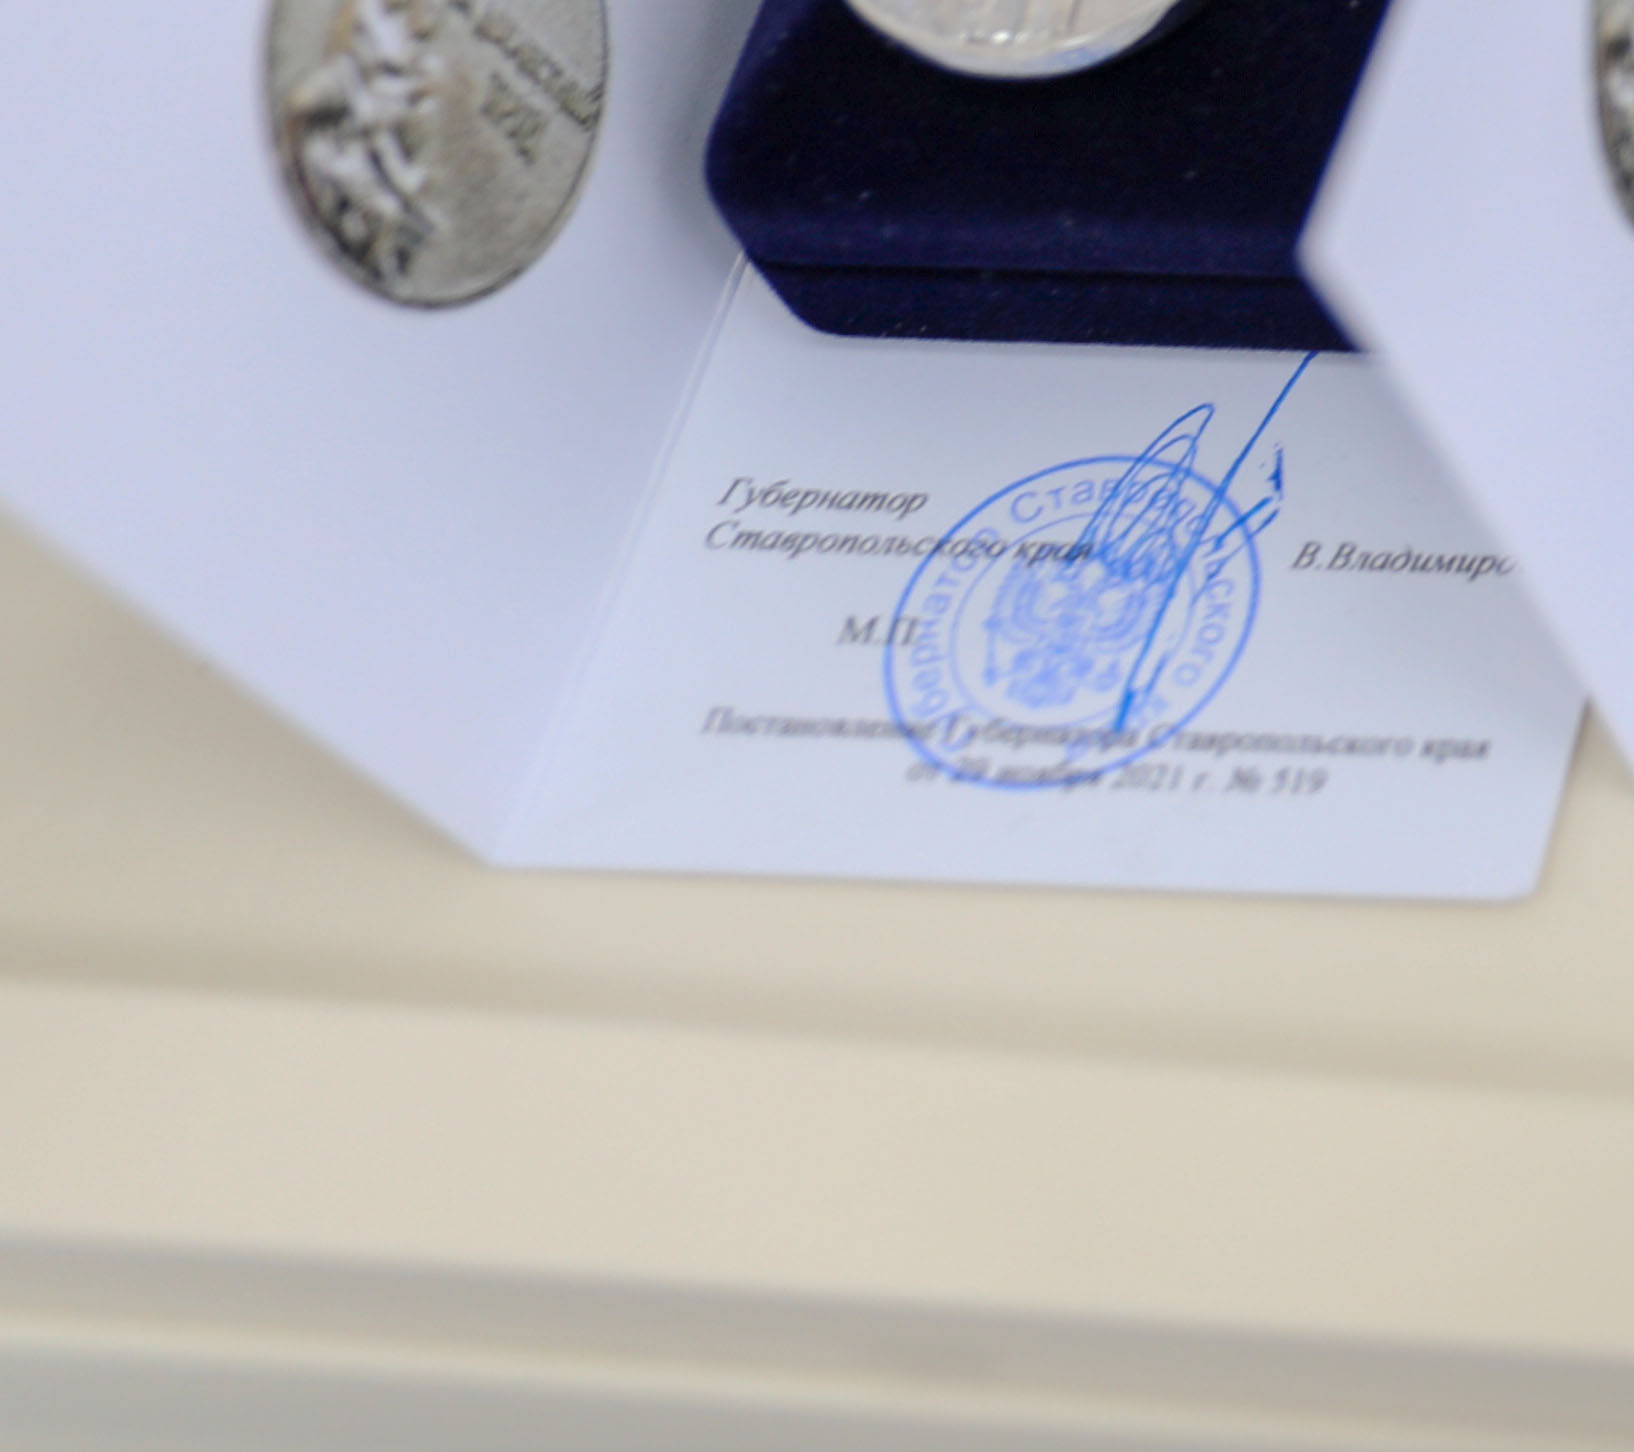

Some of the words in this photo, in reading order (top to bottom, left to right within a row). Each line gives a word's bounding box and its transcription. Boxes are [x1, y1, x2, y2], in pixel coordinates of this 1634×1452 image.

[716, 476, 929, 521] Губернатор
[704, 519, 1005, 560] Ставропольского
[1291, 540, 1519, 583] В.Владимиро
[1147, 721, 1414, 758] Ставропольского
[1418, 736, 1492, 765] края
